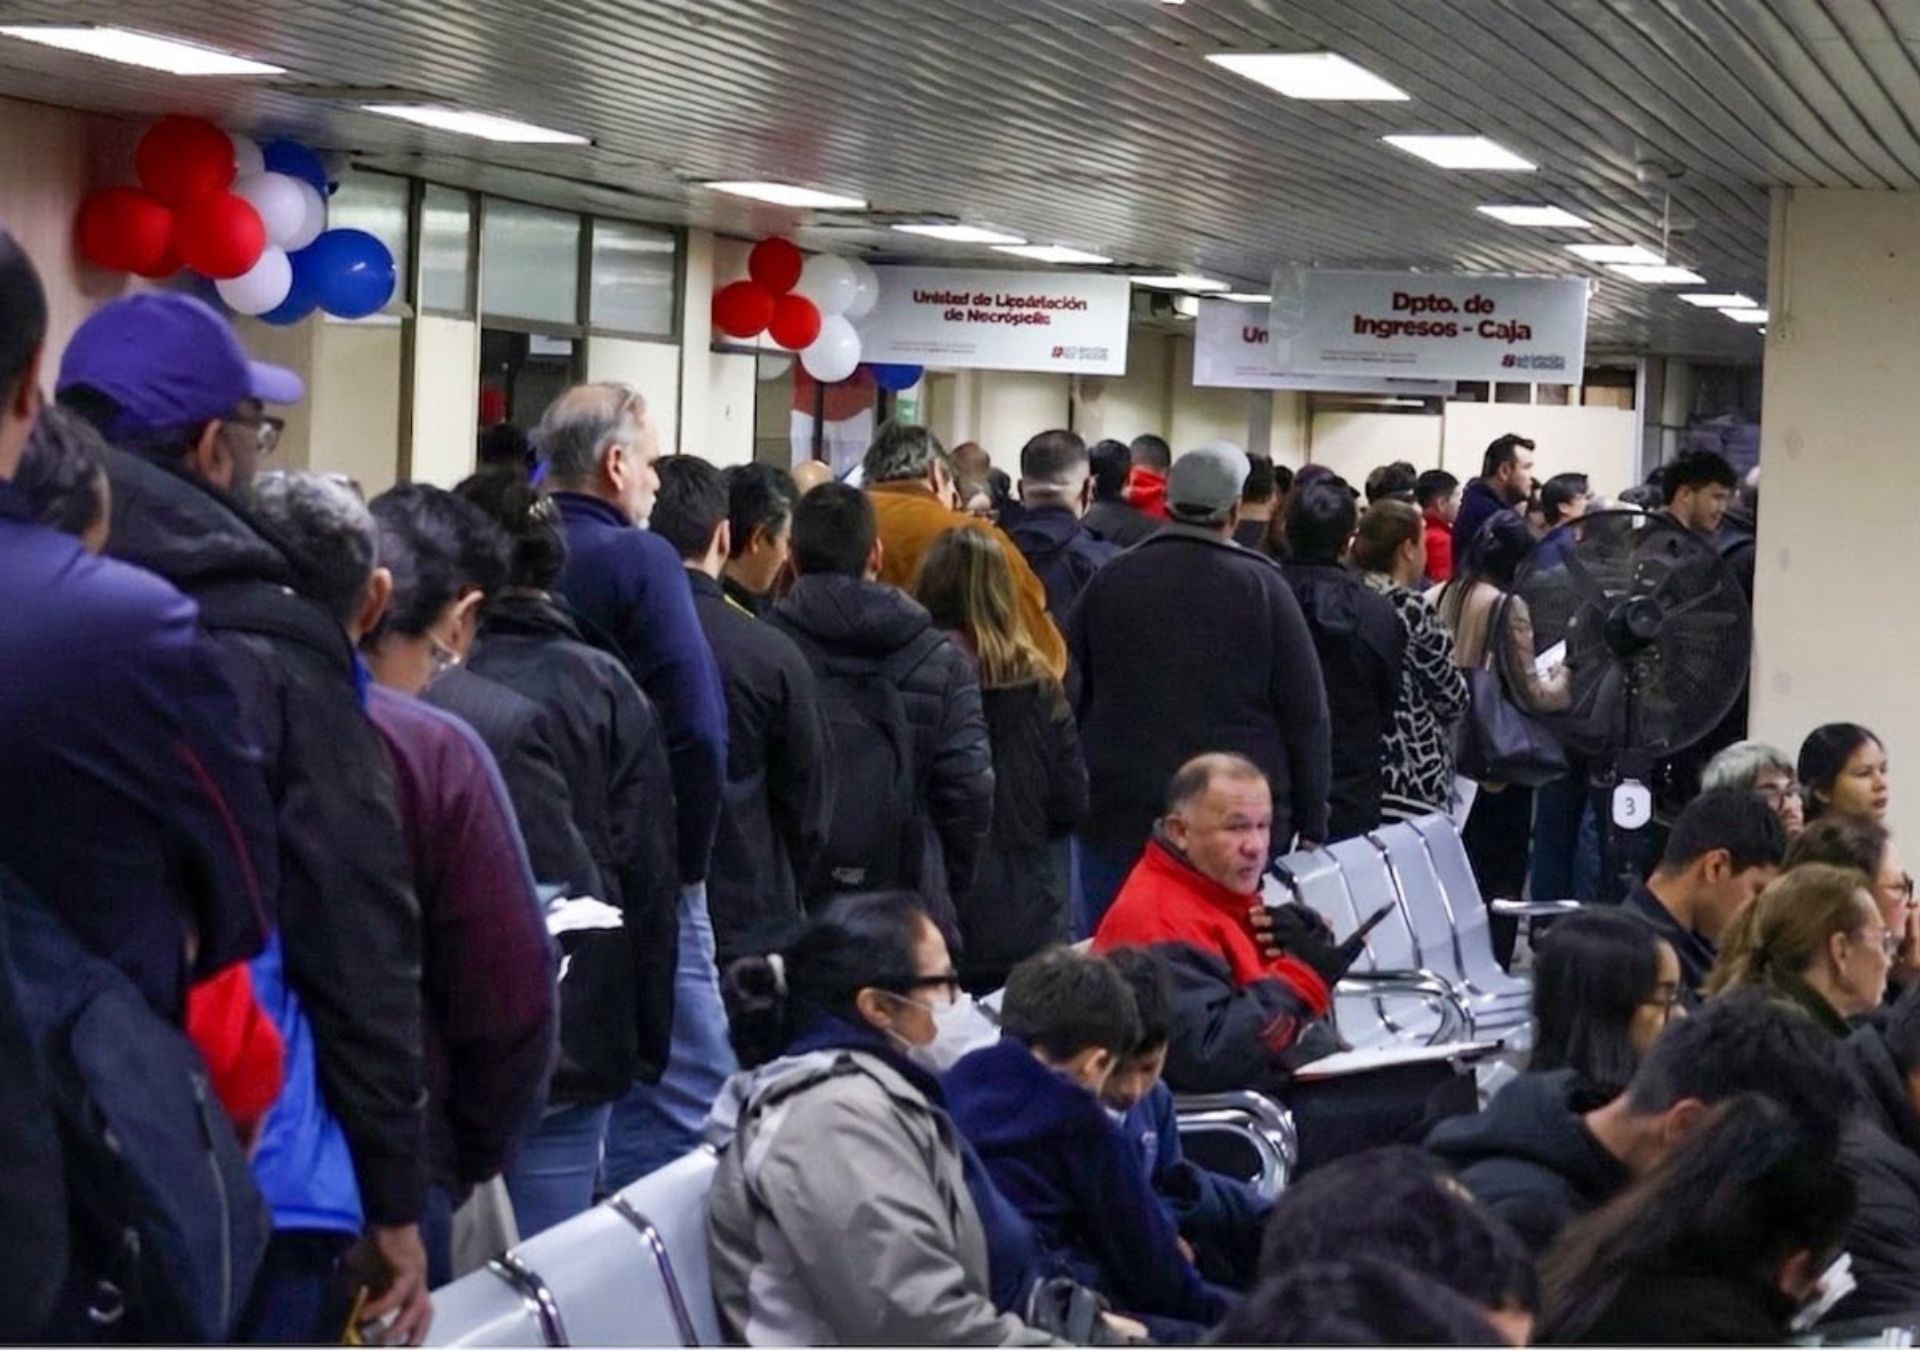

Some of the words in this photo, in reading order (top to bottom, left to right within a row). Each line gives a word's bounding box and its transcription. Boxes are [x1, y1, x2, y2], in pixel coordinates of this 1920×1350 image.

[972, 292, 992, 307] de
[1392, 291, 1459, 316] Dpto.
[1464, 294, 1495, 314] de
[944, 308, 964, 321] de
[1353, 314, 1458, 339] Ingresos
[1477, 319, 1532, 344] Caja
[1624, 796, 1636, 816] 3
